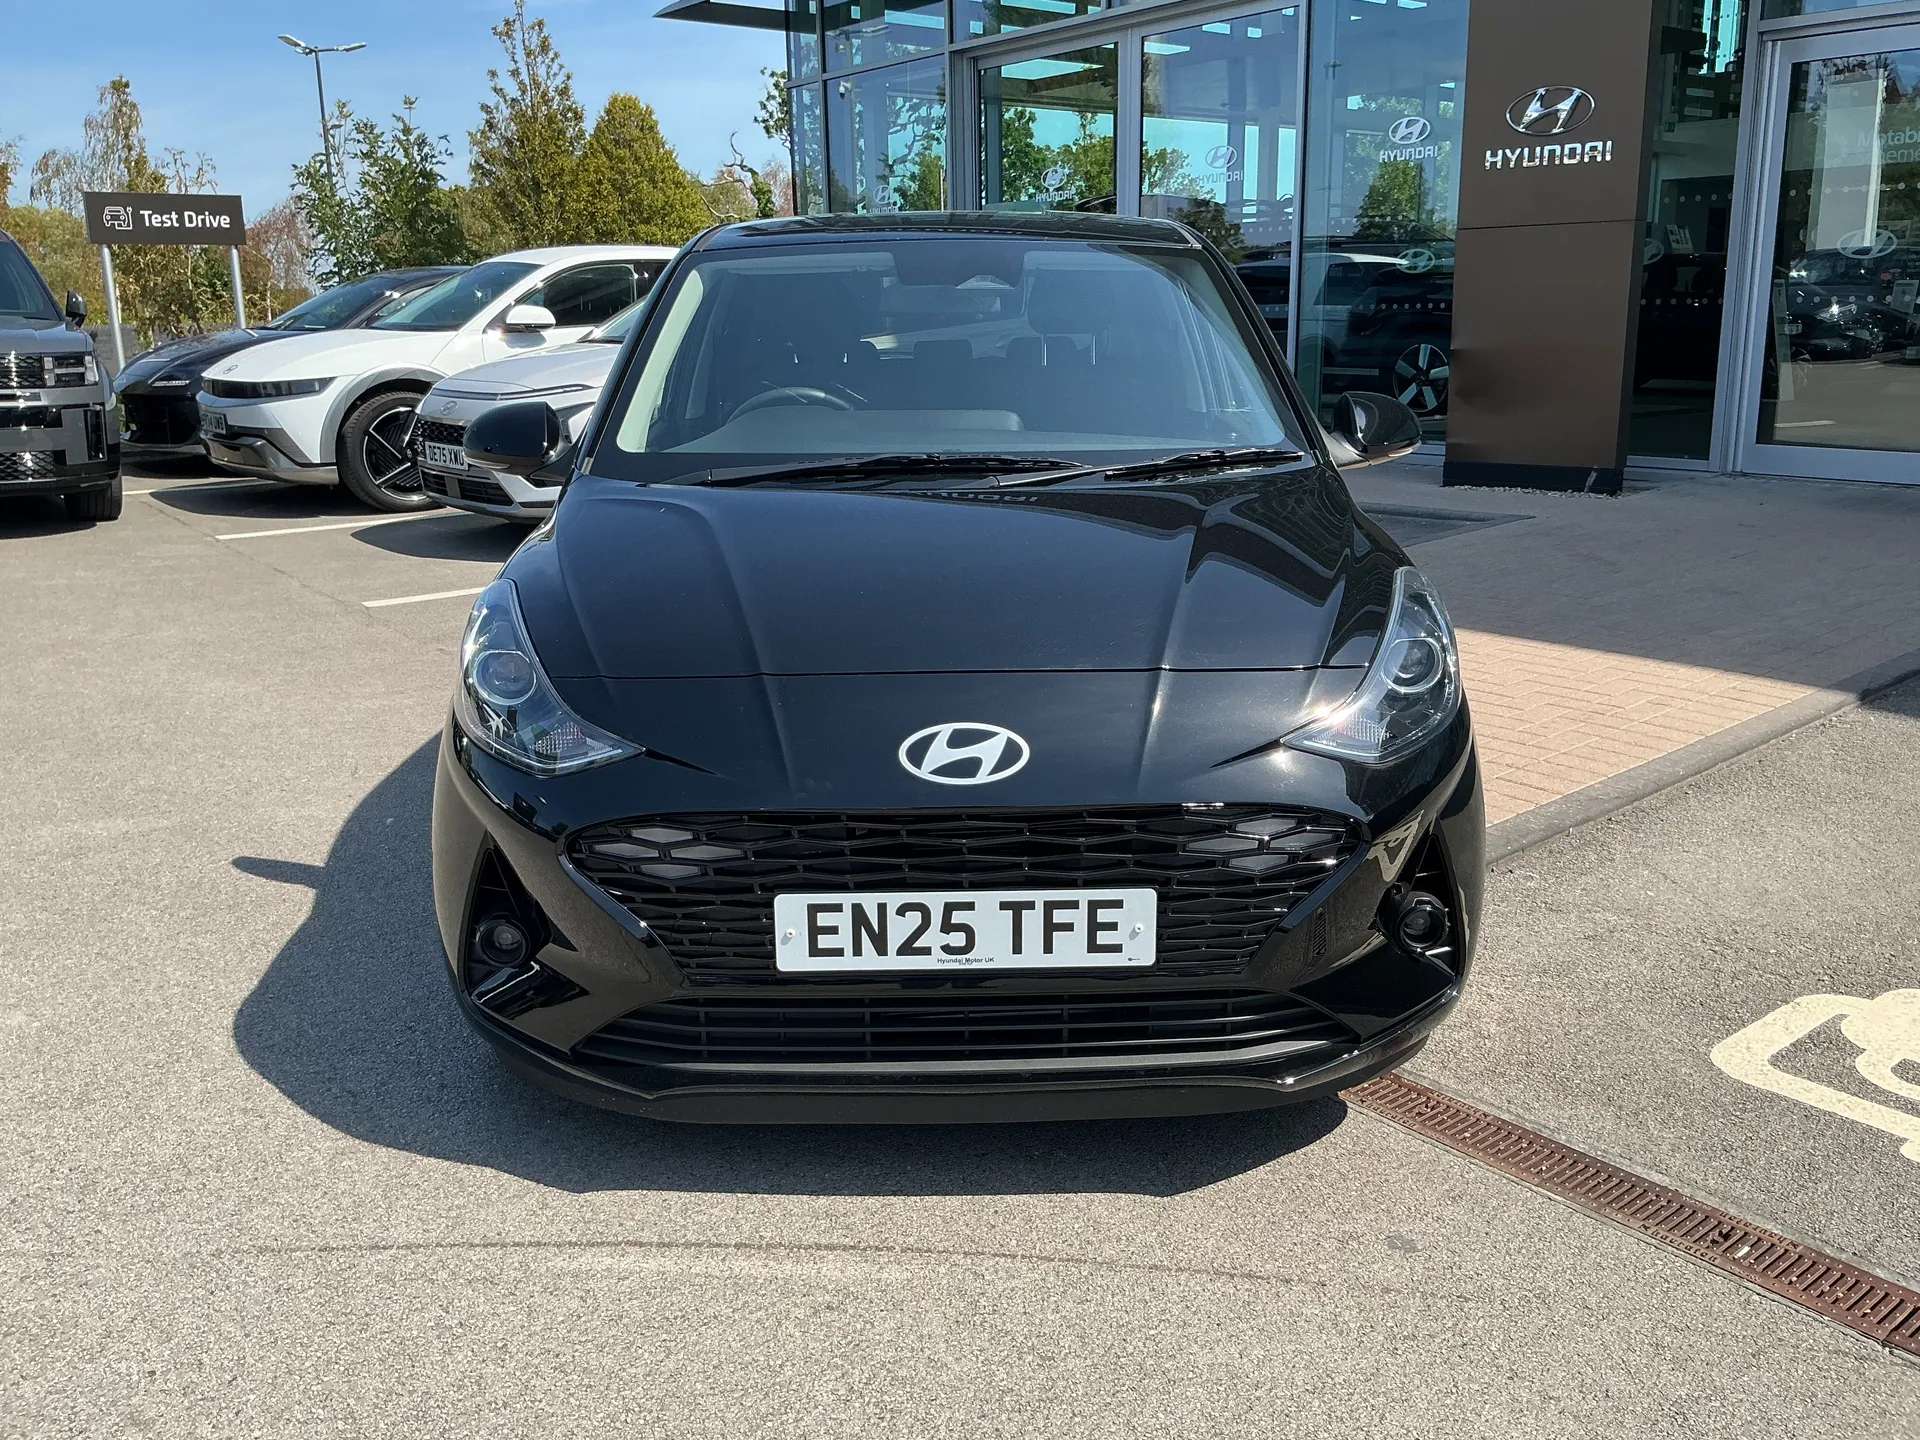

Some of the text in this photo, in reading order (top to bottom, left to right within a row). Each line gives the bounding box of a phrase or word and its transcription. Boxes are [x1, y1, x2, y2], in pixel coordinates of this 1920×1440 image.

[1379, 145, 1438, 162] HYUNDAI
[1484, 140, 1612, 170] HYUNDAI
[1035, 190, 1073, 202] HYUNDAI
[140, 210, 230, 228] Test Drive
[429, 445, 447, 464] DE75
[807, 899, 1124, 957] EN25 TFE
